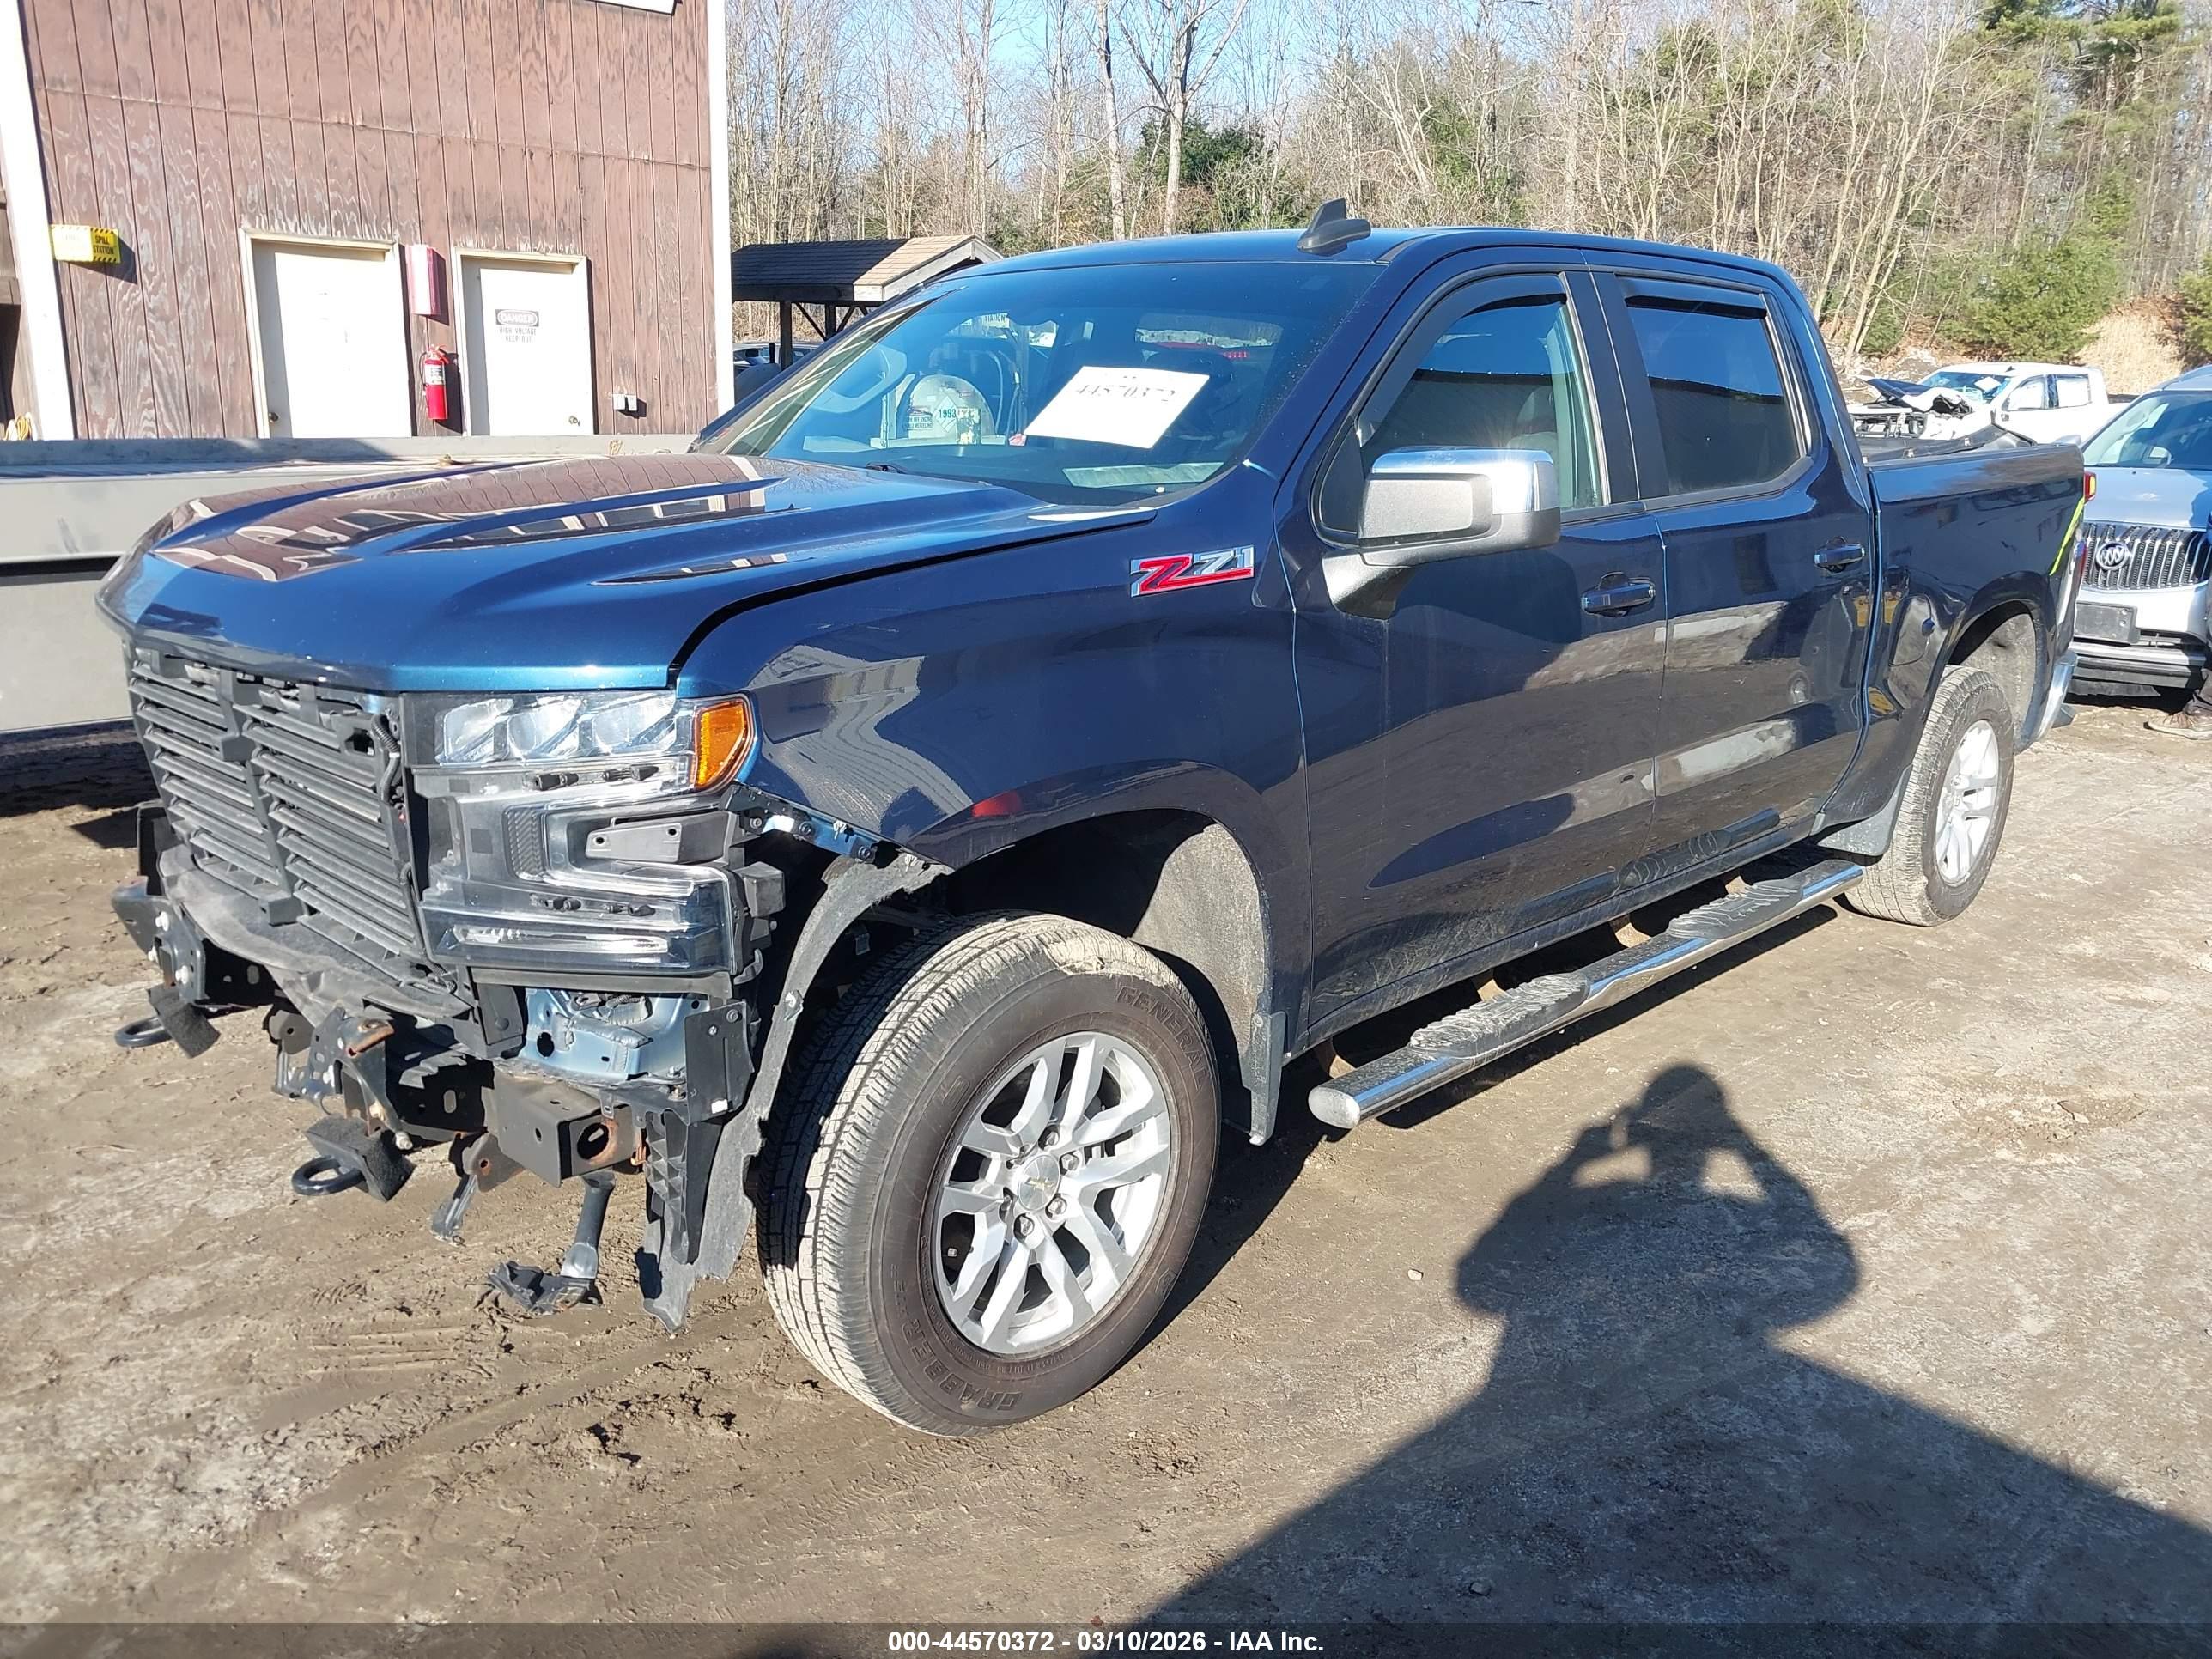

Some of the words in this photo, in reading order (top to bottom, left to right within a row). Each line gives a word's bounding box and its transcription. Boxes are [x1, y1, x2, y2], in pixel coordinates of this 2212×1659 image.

[94, 234, 110, 245] SPILL
[93, 245, 114, 255] STATION
[501, 313, 534, 324] DANGER
[515, 327, 537, 336] VOLTAGE
[521, 335, 532, 343] OUT
[939, 408, 957, 418] 1993
[1130, 544, 1255, 598] Z71
[1116, 982, 1207, 1092] GENERAL
[902, 1318, 1023, 1410] GRABBER
